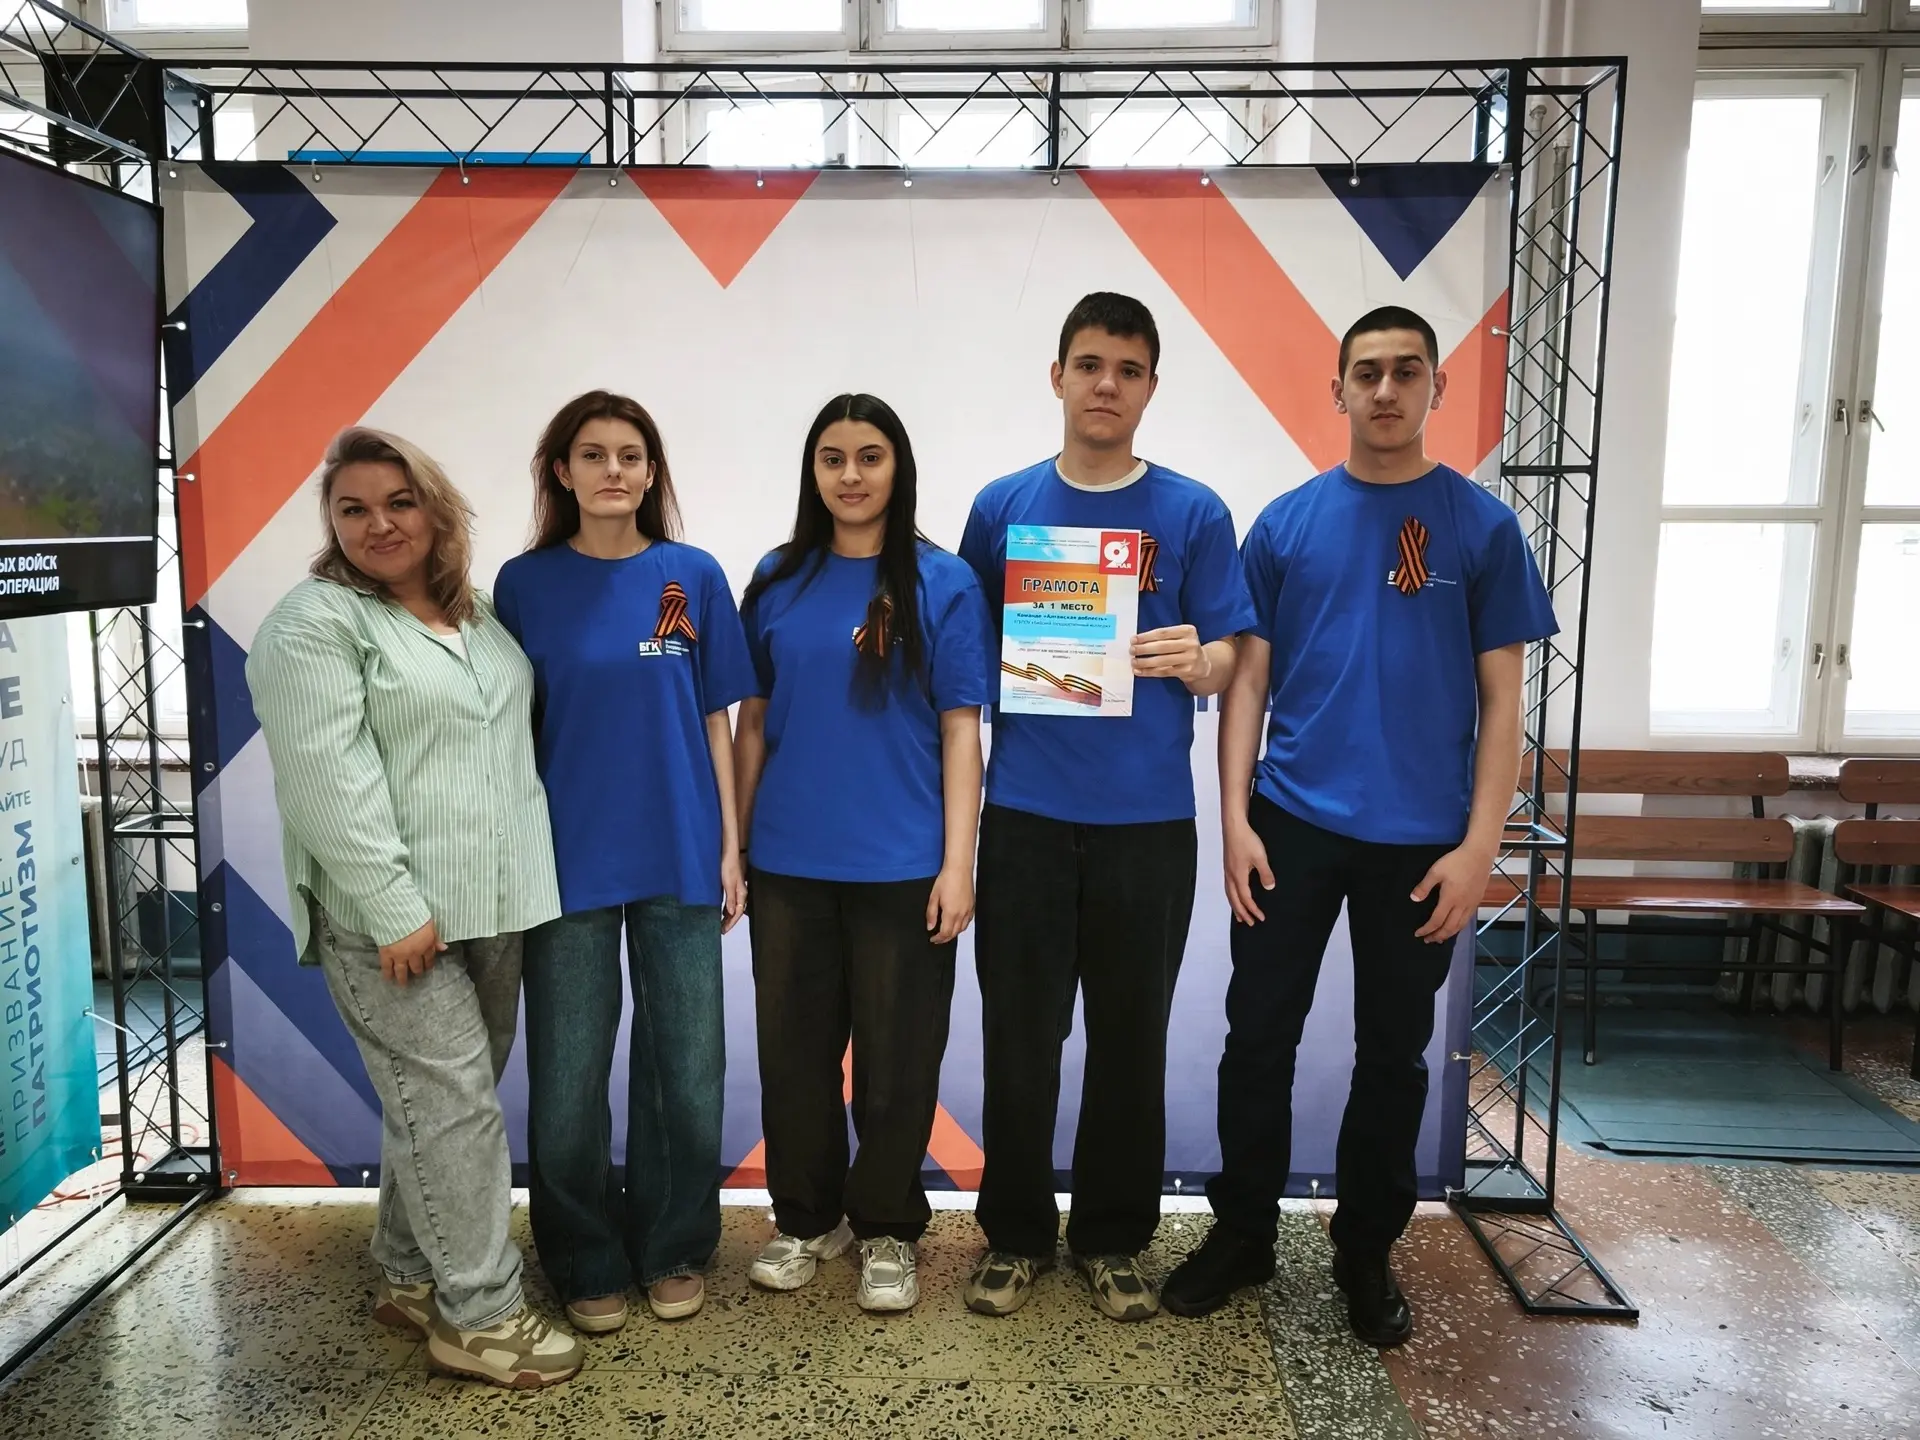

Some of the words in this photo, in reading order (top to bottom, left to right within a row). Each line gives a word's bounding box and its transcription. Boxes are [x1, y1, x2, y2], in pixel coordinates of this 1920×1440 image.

[18, 553, 58, 572] ВОЙСК
[0, 576, 60, 595] ОПЕРАЦИЯ
[1022, 578, 1100, 594] ГРАМОТА
[1061, 603, 1094, 611] МЕСТО
[639, 641, 659, 652] БГК
[14, 819, 46, 1129] ПАТРИОТИЗМ
[0, 876, 30, 1143] ПРИЗВАНИЕ
